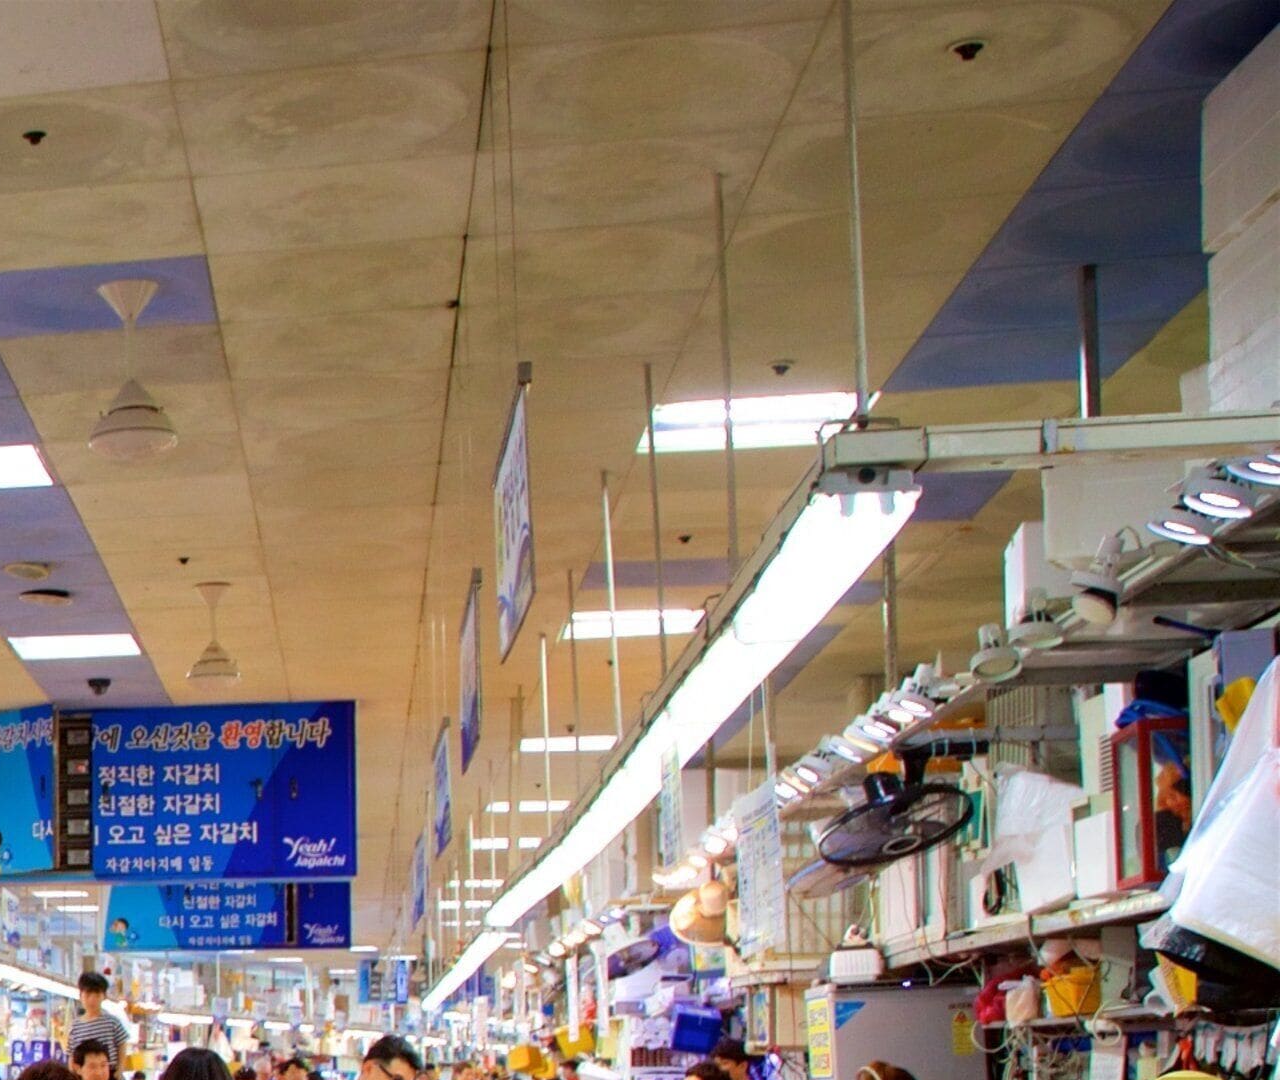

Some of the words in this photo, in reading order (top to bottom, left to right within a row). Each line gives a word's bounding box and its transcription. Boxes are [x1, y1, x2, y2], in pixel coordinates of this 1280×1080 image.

[125, 721, 214, 752] 오신것을
[220, 716, 333, 750] 환영합니다
[98, 763, 156, 787] 정직한
[163, 763, 221, 786] 자갈치
[163, 793, 221, 816] 자갈치
[107, 823, 146, 845] 오고
[153, 823, 193, 846] 싶은
[200, 820, 258, 844] 자갈치
[283, 836, 337, 861] Yeah!
[105, 856, 184, 874] 자갈치아지매
[189, 855, 214, 872] 일동
[294, 855, 346, 869] Jagalchi
[224, 893, 257, 909] 자갈치
[158, 915, 185, 930] 다시
[189, 915, 215, 929] 오고
[244, 911, 278, 927] 자갈치
